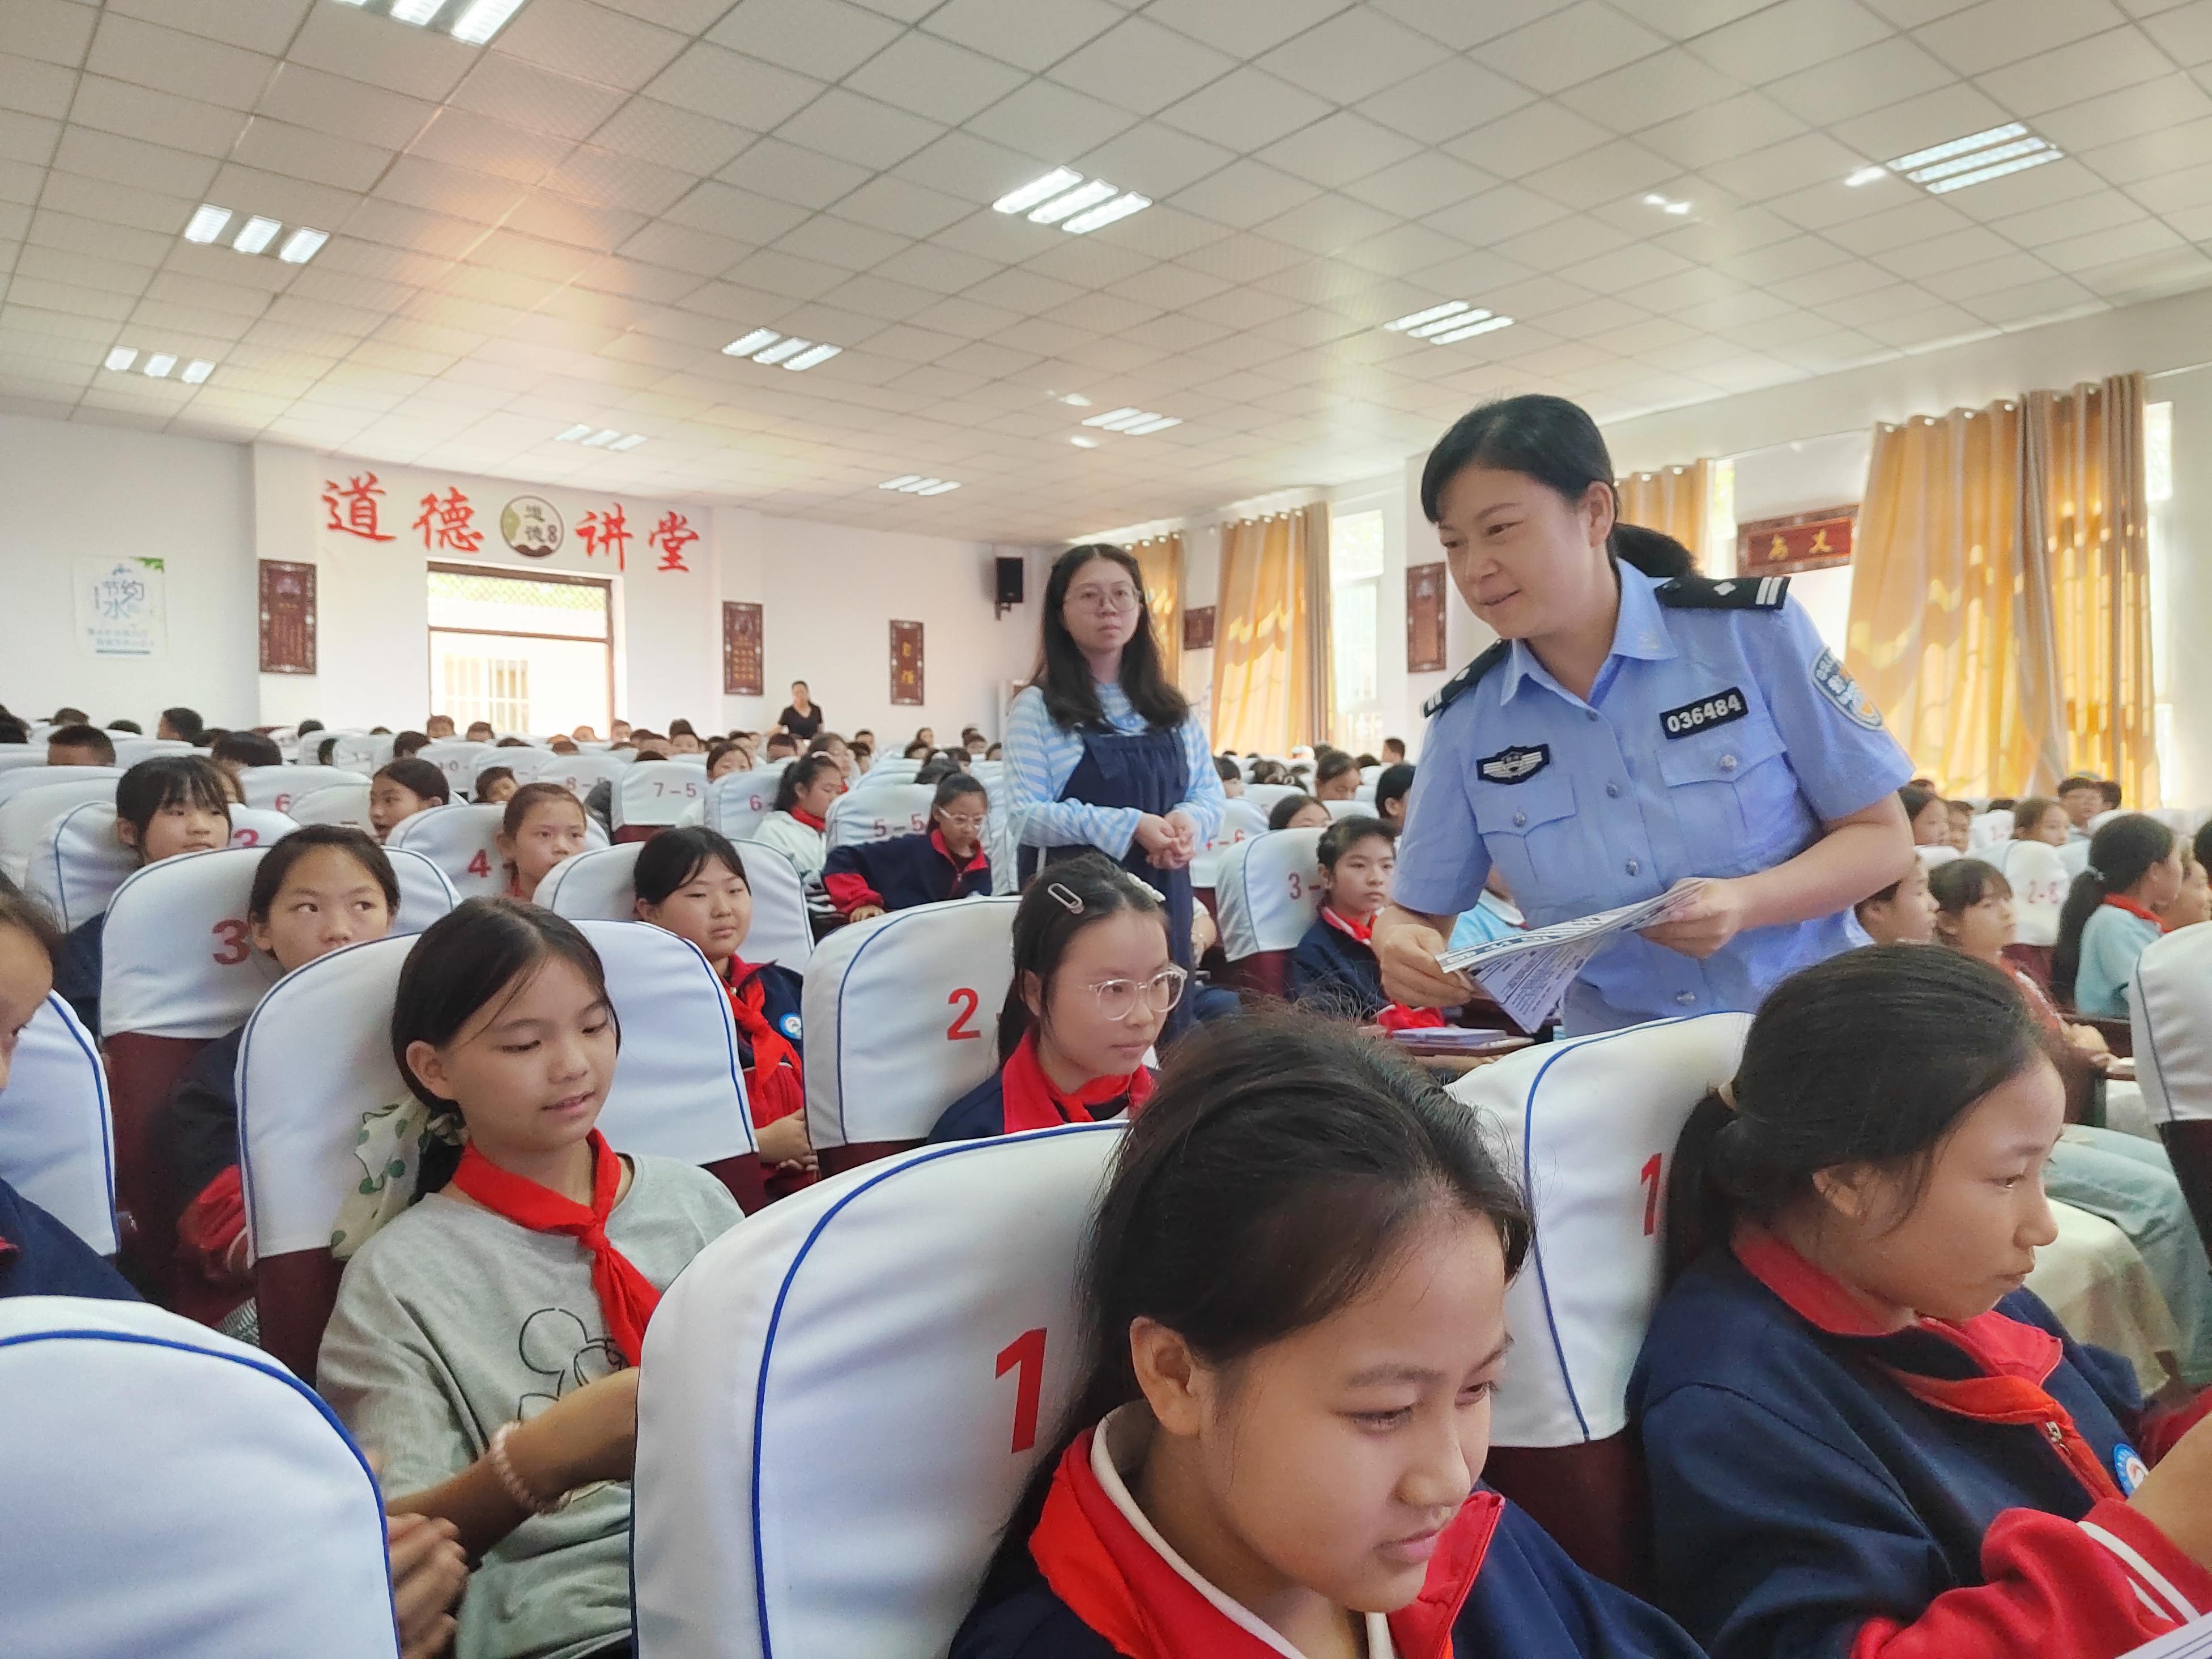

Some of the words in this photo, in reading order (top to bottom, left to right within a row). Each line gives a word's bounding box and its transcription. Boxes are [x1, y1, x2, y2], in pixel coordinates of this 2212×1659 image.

[322, 470, 484, 552] 道德
[575, 502, 699, 571] 讲堂
[1667, 694, 1741, 732] 036484
[653, 782, 696, 798] 7-5
[874, 813, 925, 837] 5-5
[467, 848, 492, 878] 4
[212, 920, 250, 964] 3
[947, 988, 981, 1040] 2
[1641, 1152, 1662, 1236] 1
[995, 1327, 1047, 1454] 1
